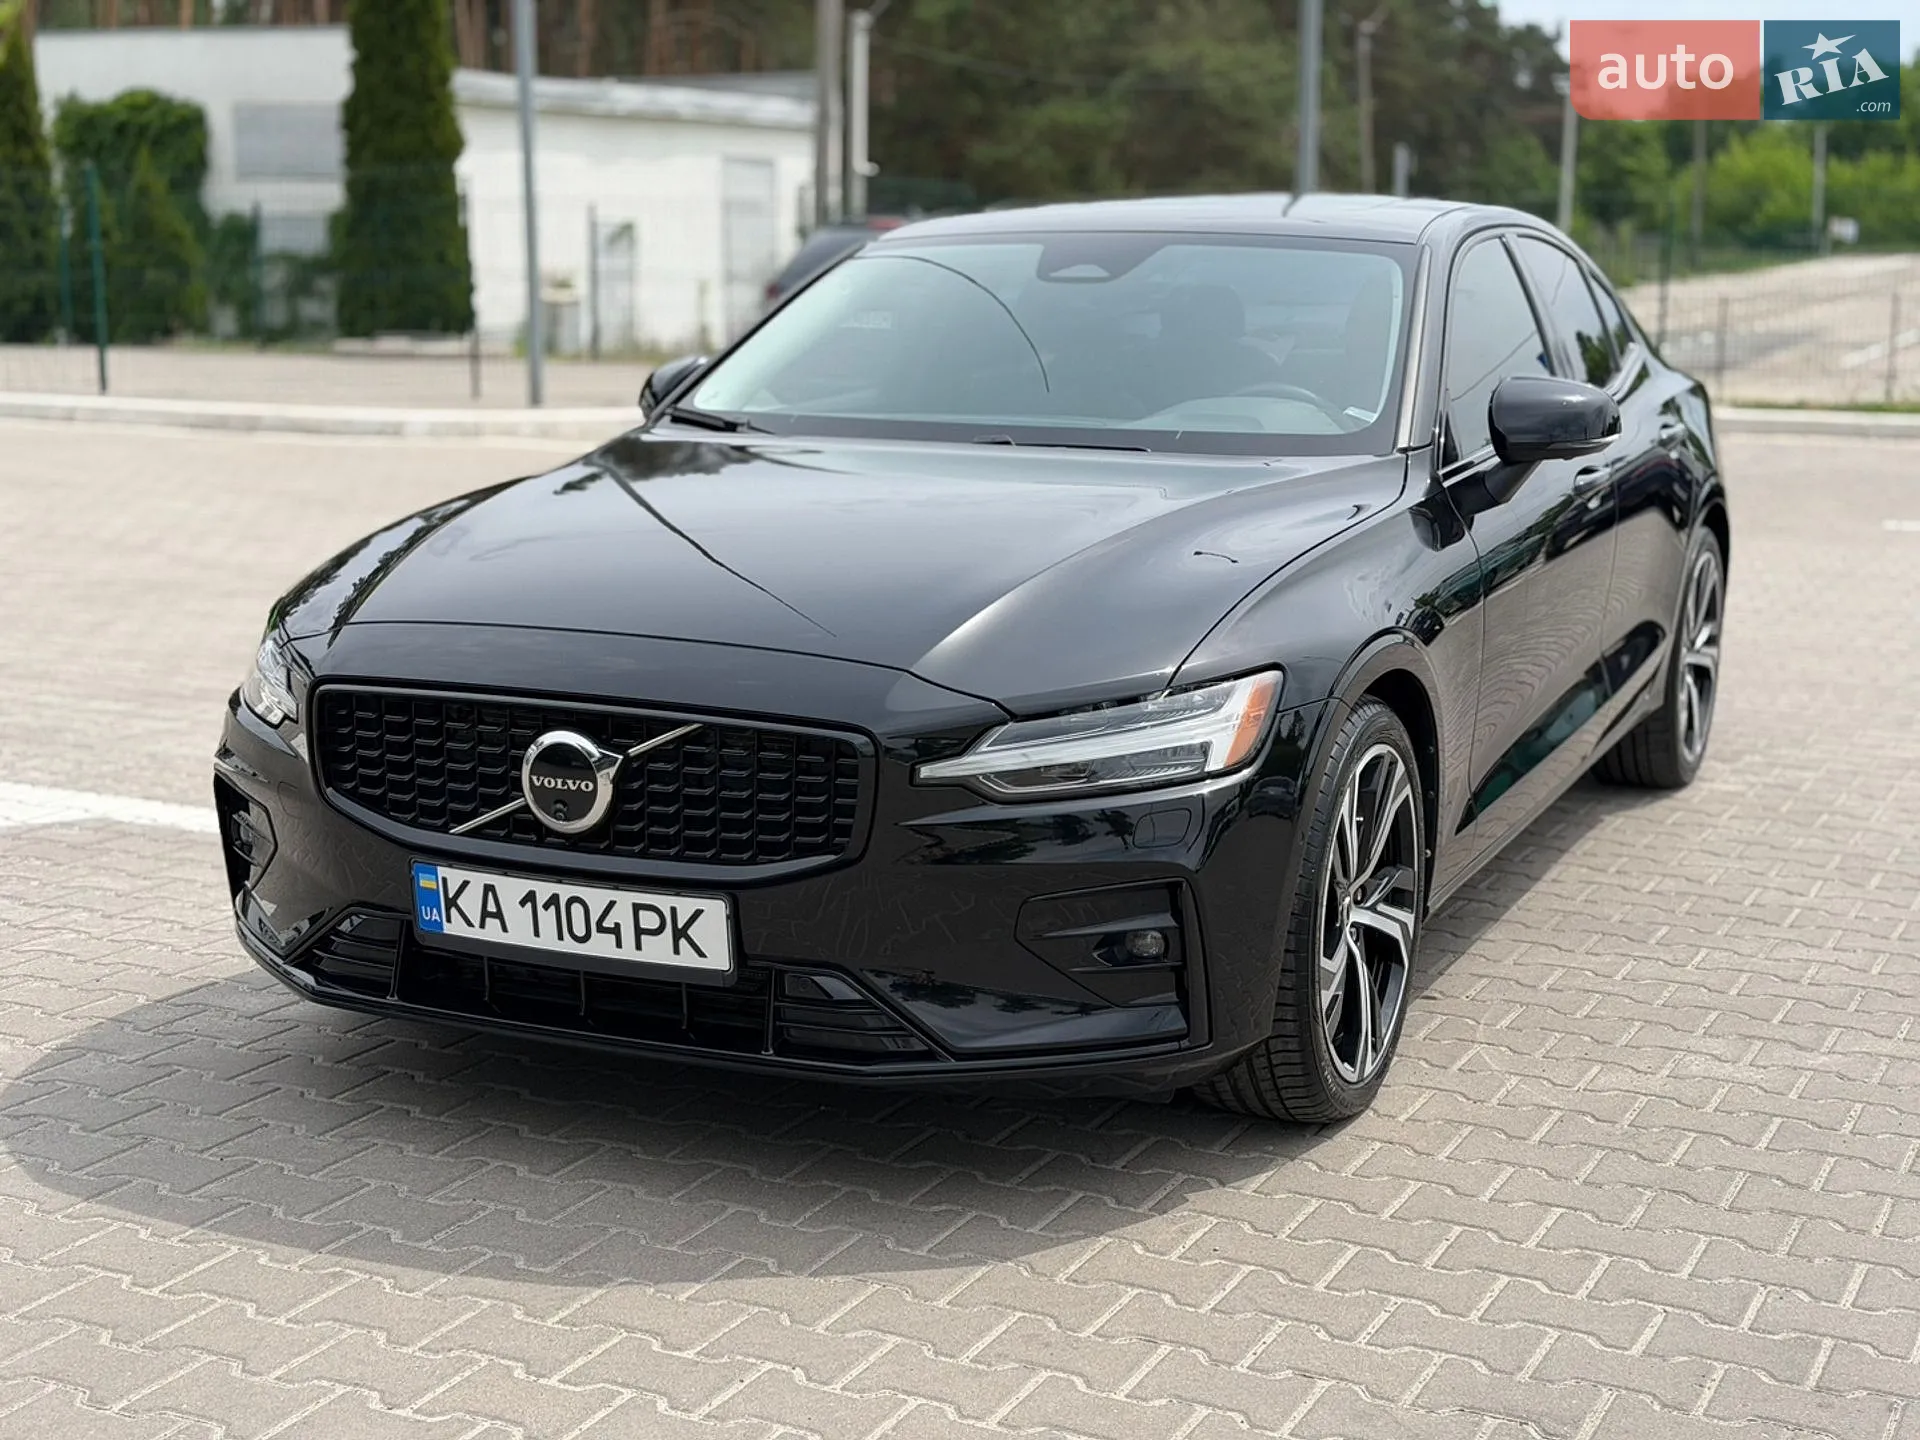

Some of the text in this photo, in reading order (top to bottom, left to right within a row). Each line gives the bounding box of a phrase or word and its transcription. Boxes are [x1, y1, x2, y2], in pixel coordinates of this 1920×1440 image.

[530, 775, 594, 792] VOLVO
[421, 905, 440, 923] UA
[441, 876, 707, 958] KA 1104 PK
